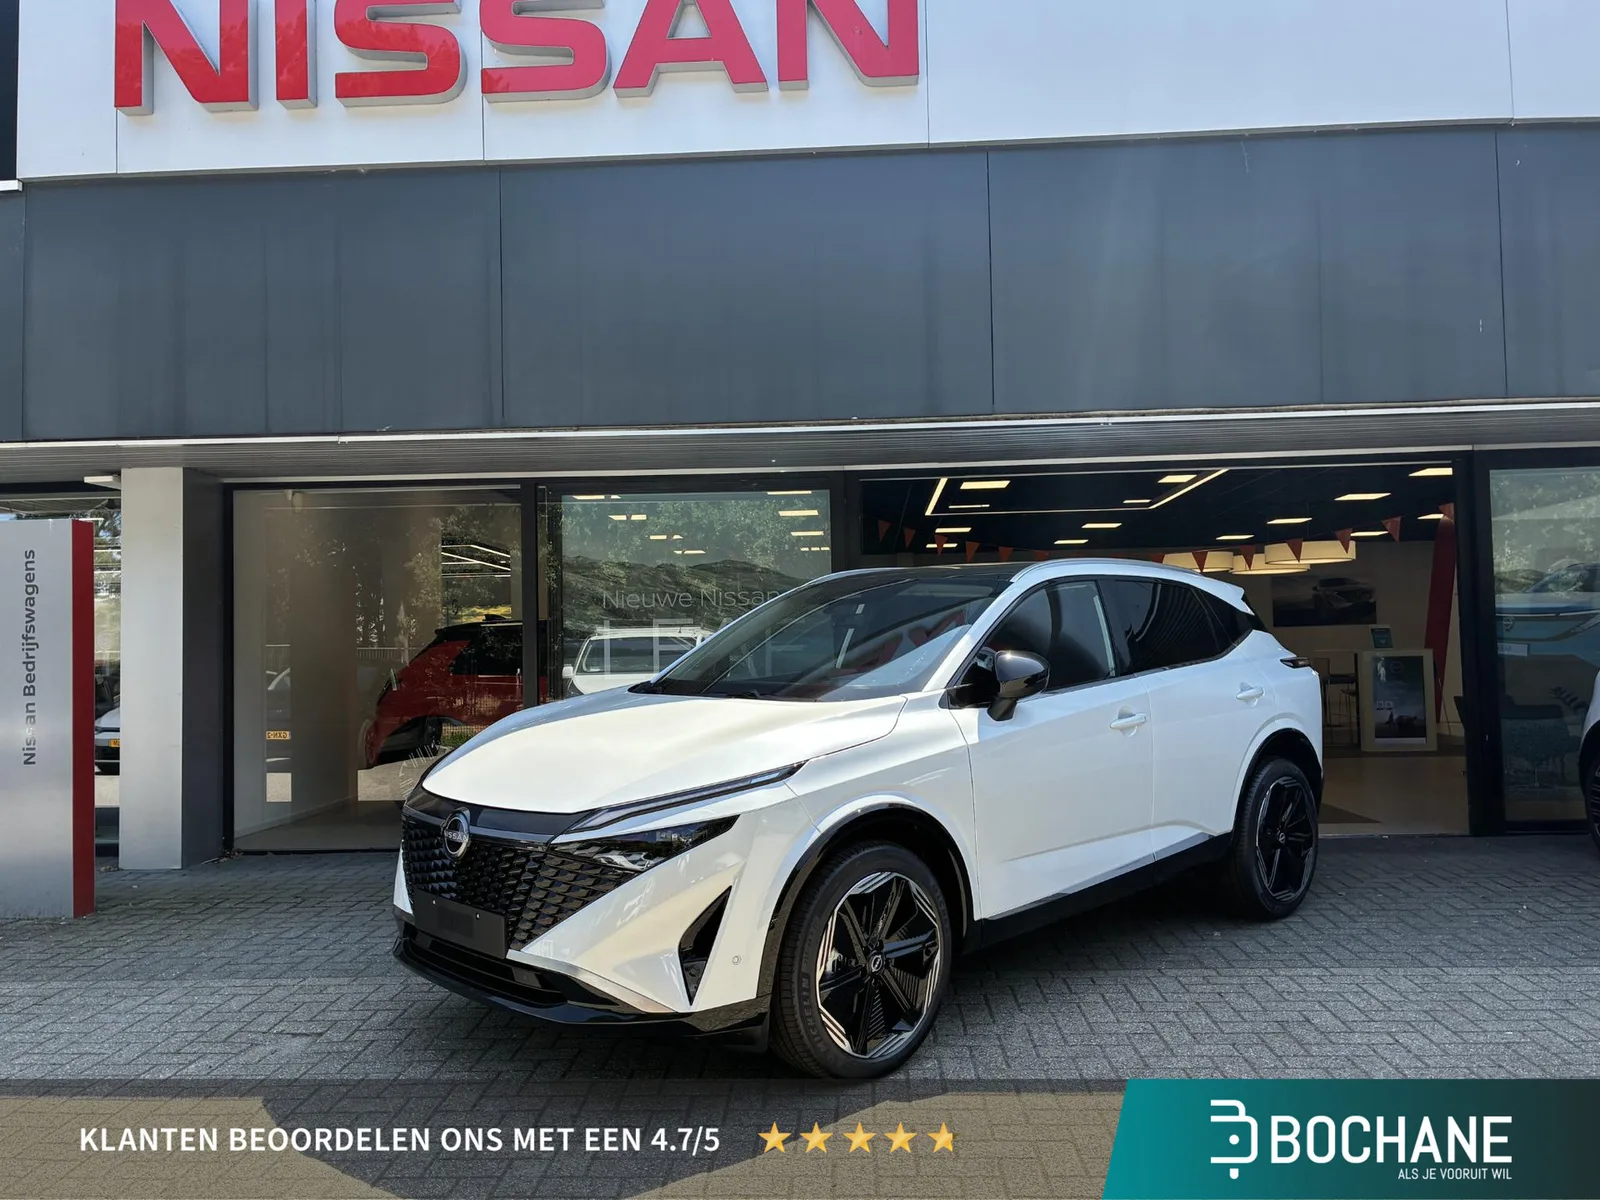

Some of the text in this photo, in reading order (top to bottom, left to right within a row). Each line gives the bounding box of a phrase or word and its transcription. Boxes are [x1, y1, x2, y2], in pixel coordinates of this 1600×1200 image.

[114, 0, 921, 113] NISSAN
[21, 549, 39, 697] Bedrijfswagens
[602, 590, 781, 610] Nieuwe Nissan
[444, 830, 470, 842] SSAN
